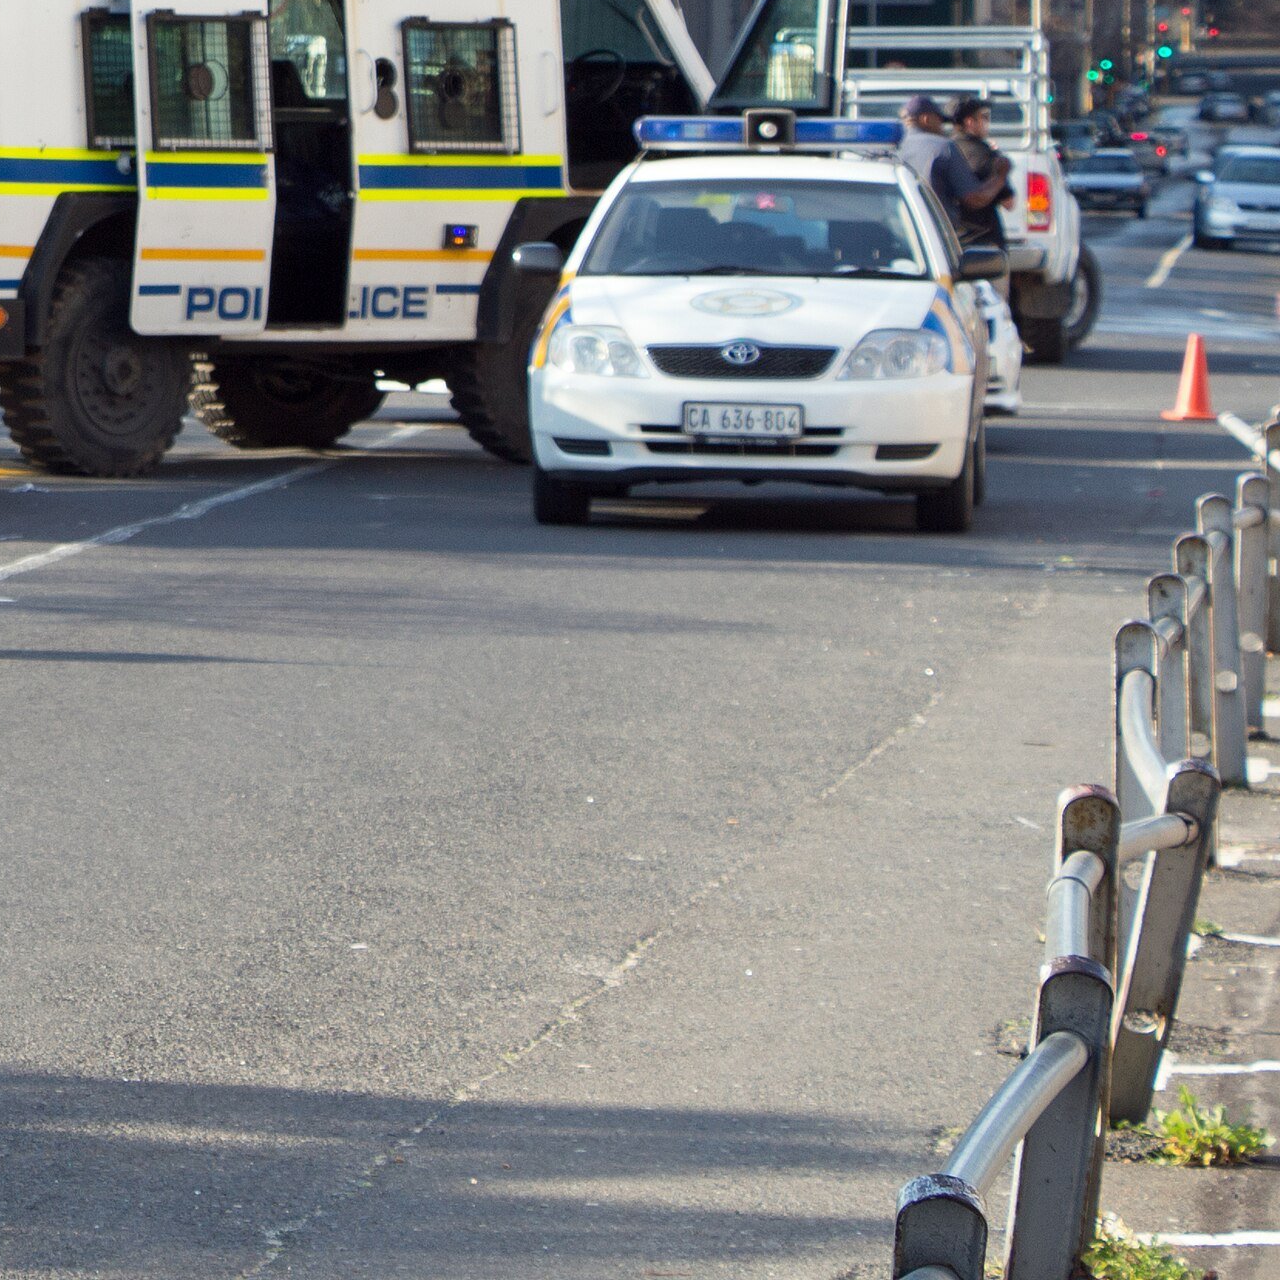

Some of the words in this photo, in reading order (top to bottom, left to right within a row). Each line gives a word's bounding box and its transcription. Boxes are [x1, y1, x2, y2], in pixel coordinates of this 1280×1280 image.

[348, 286, 429, 320] ICE
[690, 408, 711, 428] CA
[721, 408, 797, 432] 636-804
